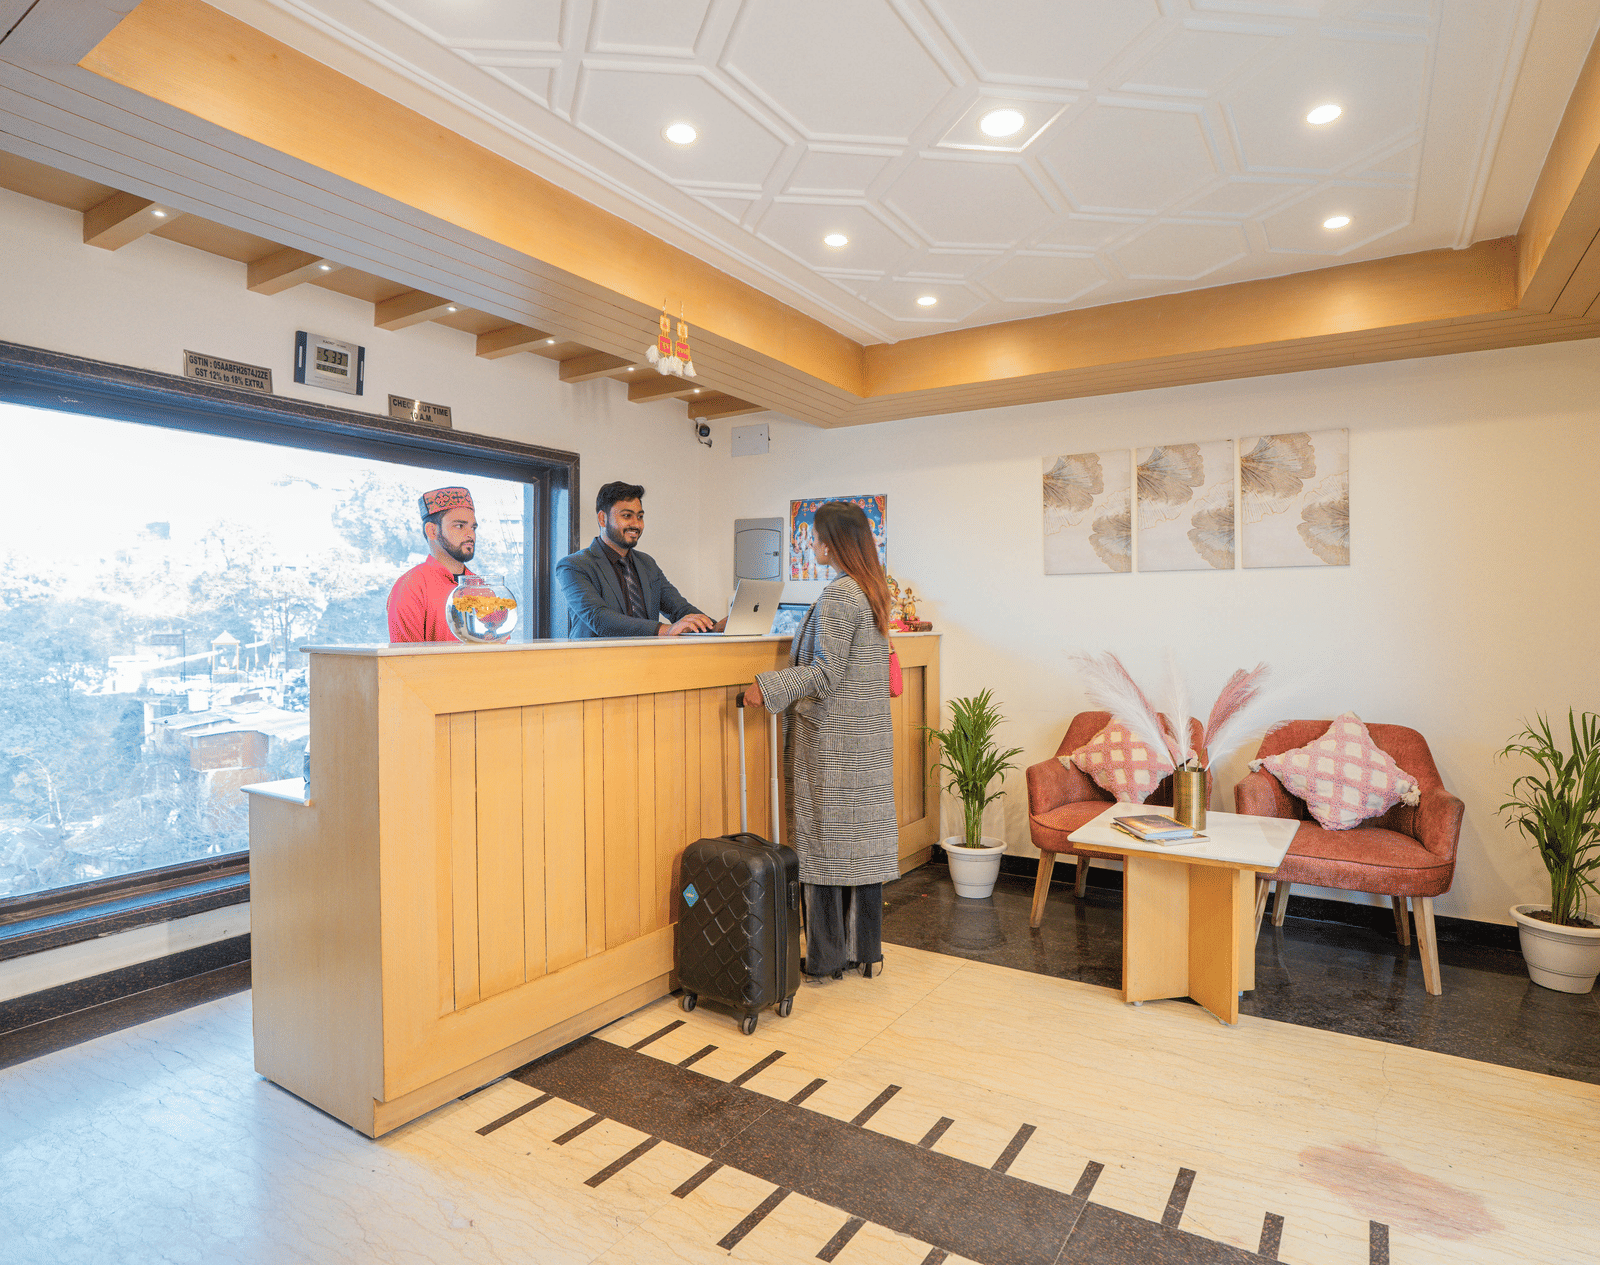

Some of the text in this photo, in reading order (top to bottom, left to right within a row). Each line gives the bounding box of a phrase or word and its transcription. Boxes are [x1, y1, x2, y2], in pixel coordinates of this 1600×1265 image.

[188, 355, 209, 367] GSTIN
[194, 367, 265, 390] GST 12% to 18% EXTRA
[392, 398, 417, 410] CHEC
[432, 406, 449, 417] TIME
[419, 413, 434, 423] A.M.
